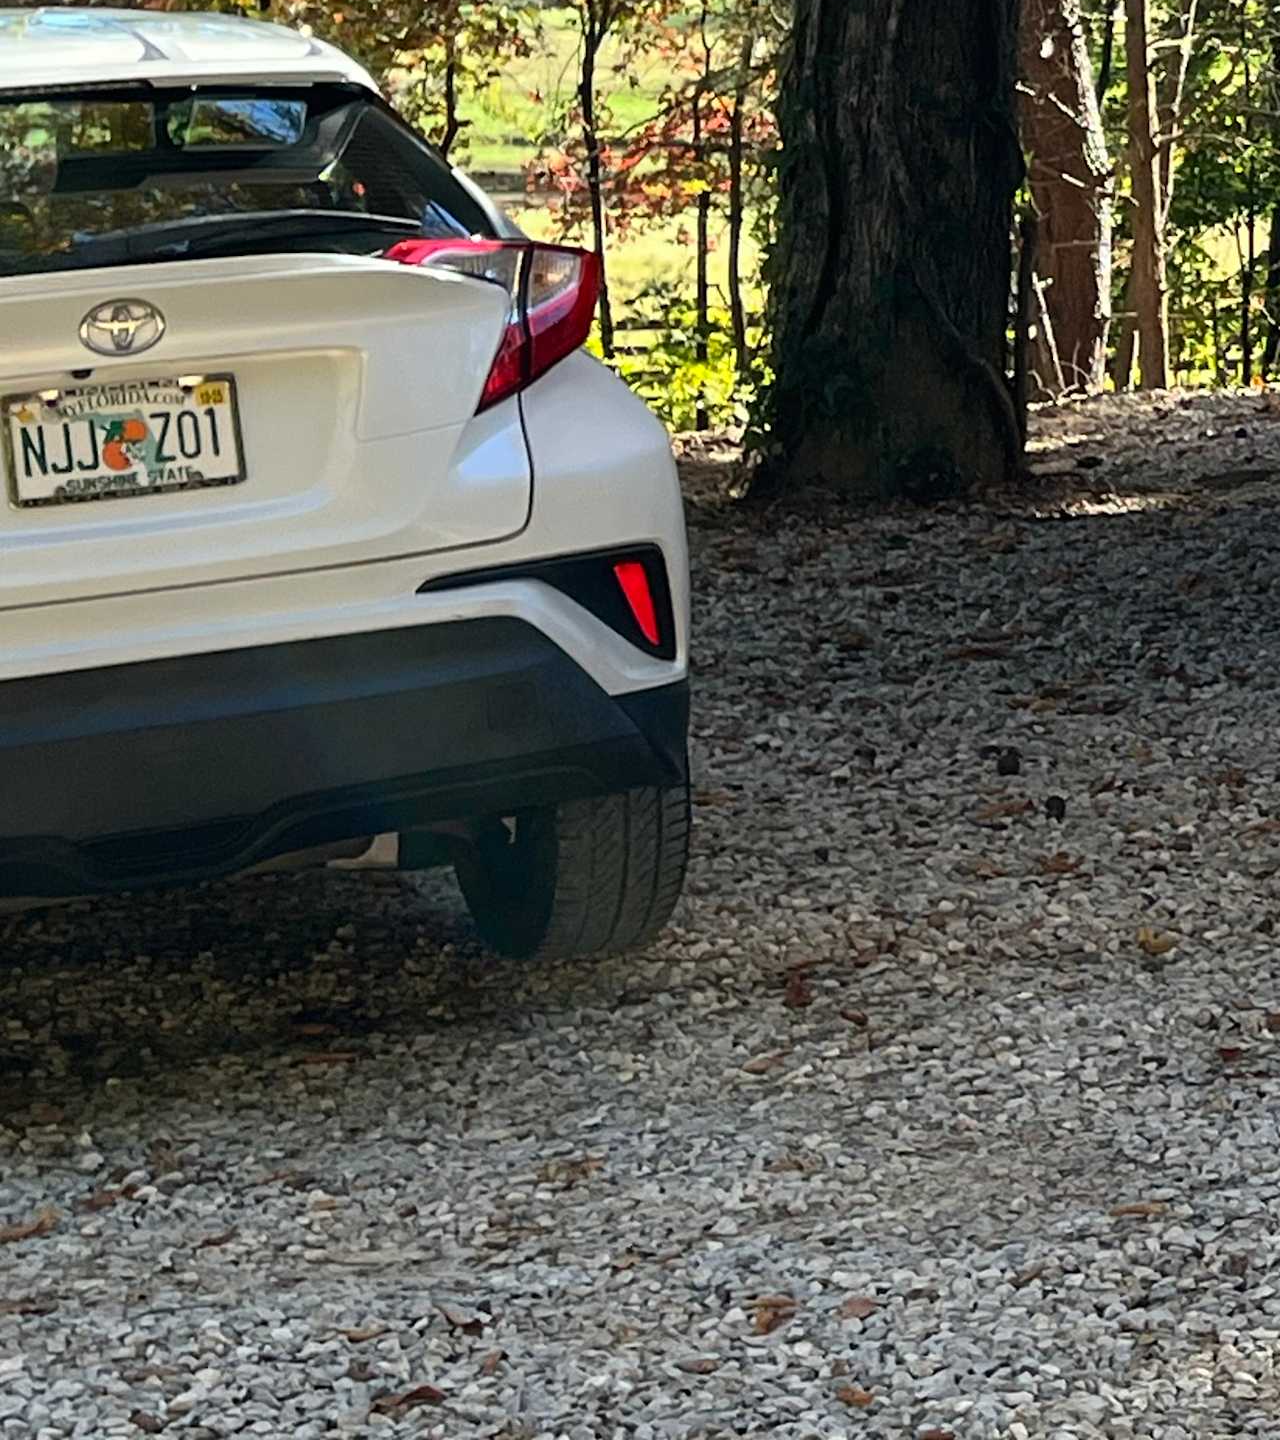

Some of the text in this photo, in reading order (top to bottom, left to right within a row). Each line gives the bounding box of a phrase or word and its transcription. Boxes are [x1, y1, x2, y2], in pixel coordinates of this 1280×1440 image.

[20, 407, 220, 477] NJJ Z01
[65, 471, 139, 494] SUNSHINE
[148, 465, 195, 484] STATE
